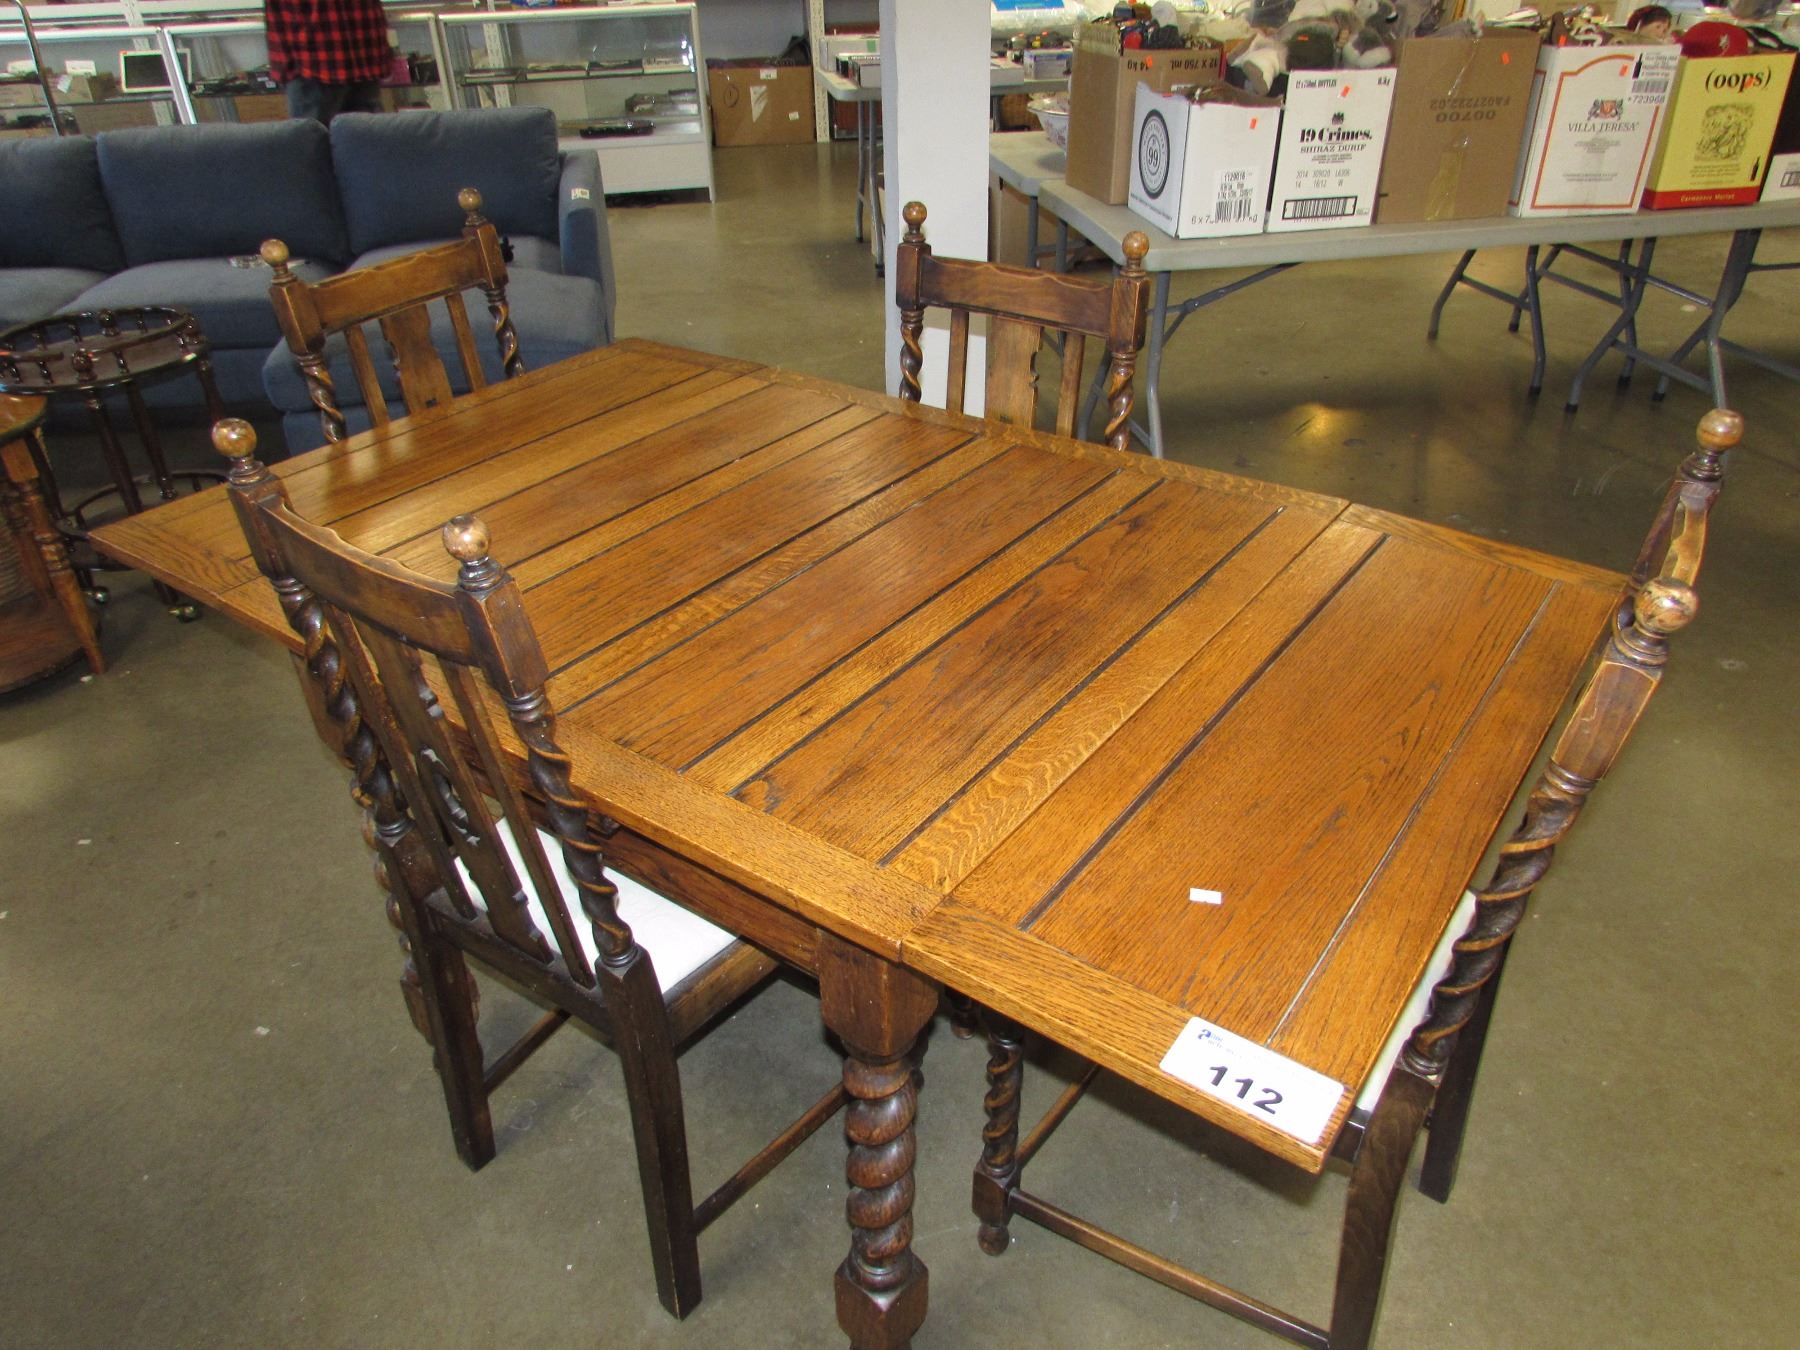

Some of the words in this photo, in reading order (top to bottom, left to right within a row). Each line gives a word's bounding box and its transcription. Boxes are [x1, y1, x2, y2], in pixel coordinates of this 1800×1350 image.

[1184, 58, 1199, 70] 750
[1705, 65, 1771, 94] (oops)
[1568, 122, 1596, 133] VILLA
[1300, 127, 1317, 143] 19
[1300, 144, 1336, 154] SHIRAZ
[1338, 143, 1367, 153] DURIF
[1209, 1065, 1283, 1115] 112
